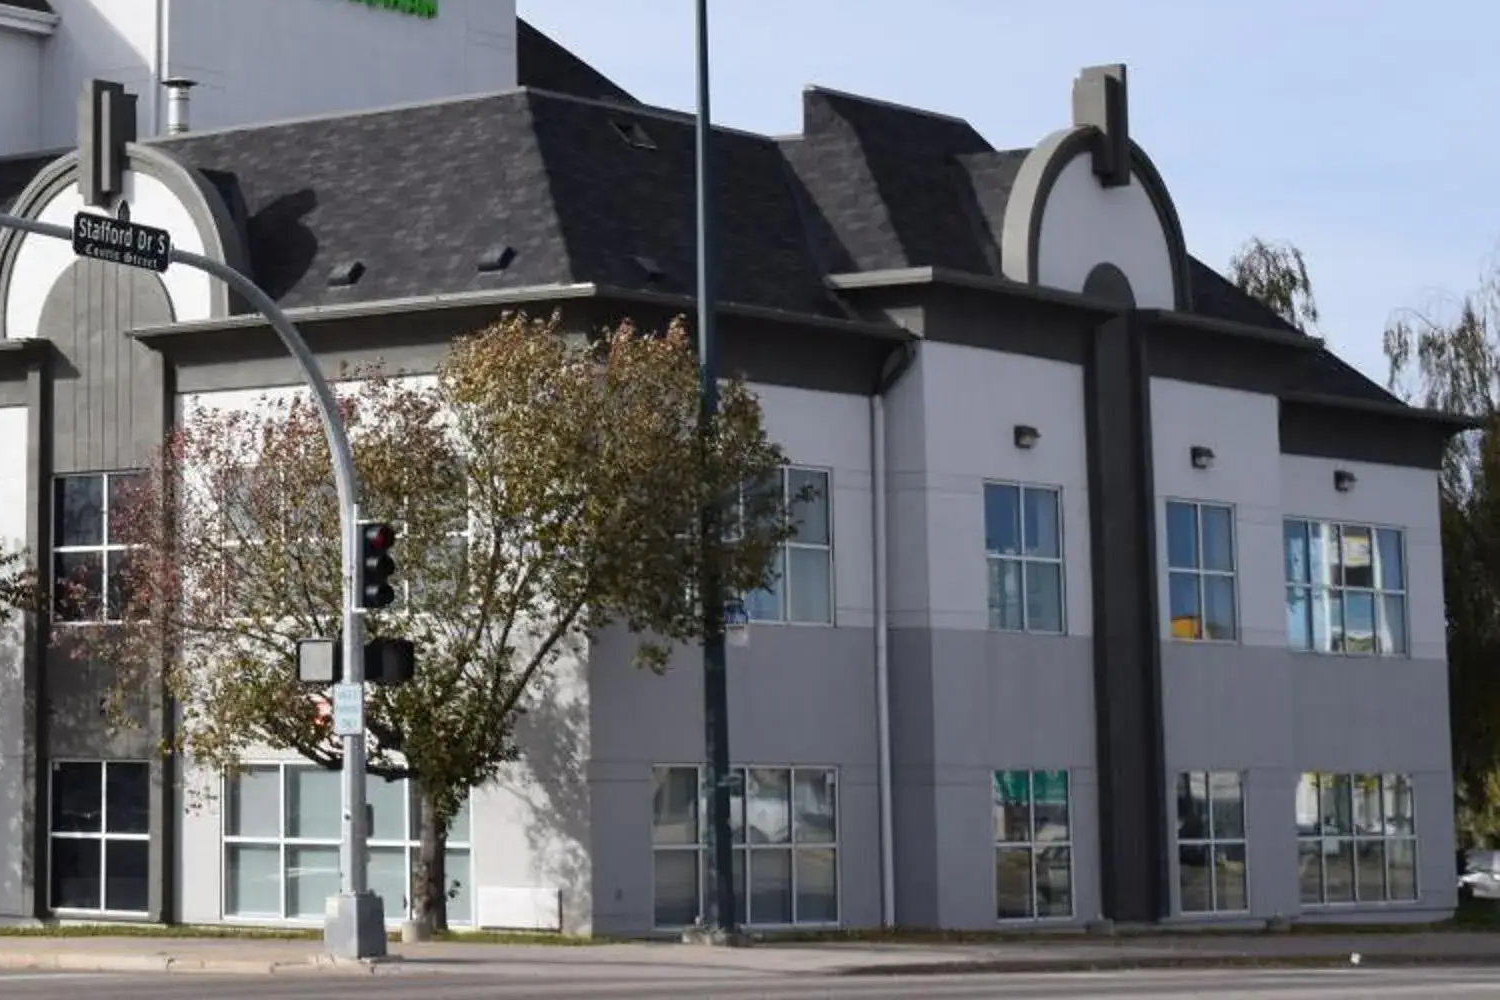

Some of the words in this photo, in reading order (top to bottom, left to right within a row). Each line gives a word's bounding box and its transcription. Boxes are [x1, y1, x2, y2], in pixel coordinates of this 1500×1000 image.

[79, 218, 133, 247] Stafford
[137, 230, 153, 250] Dr
[157, 235, 165, 254] S
